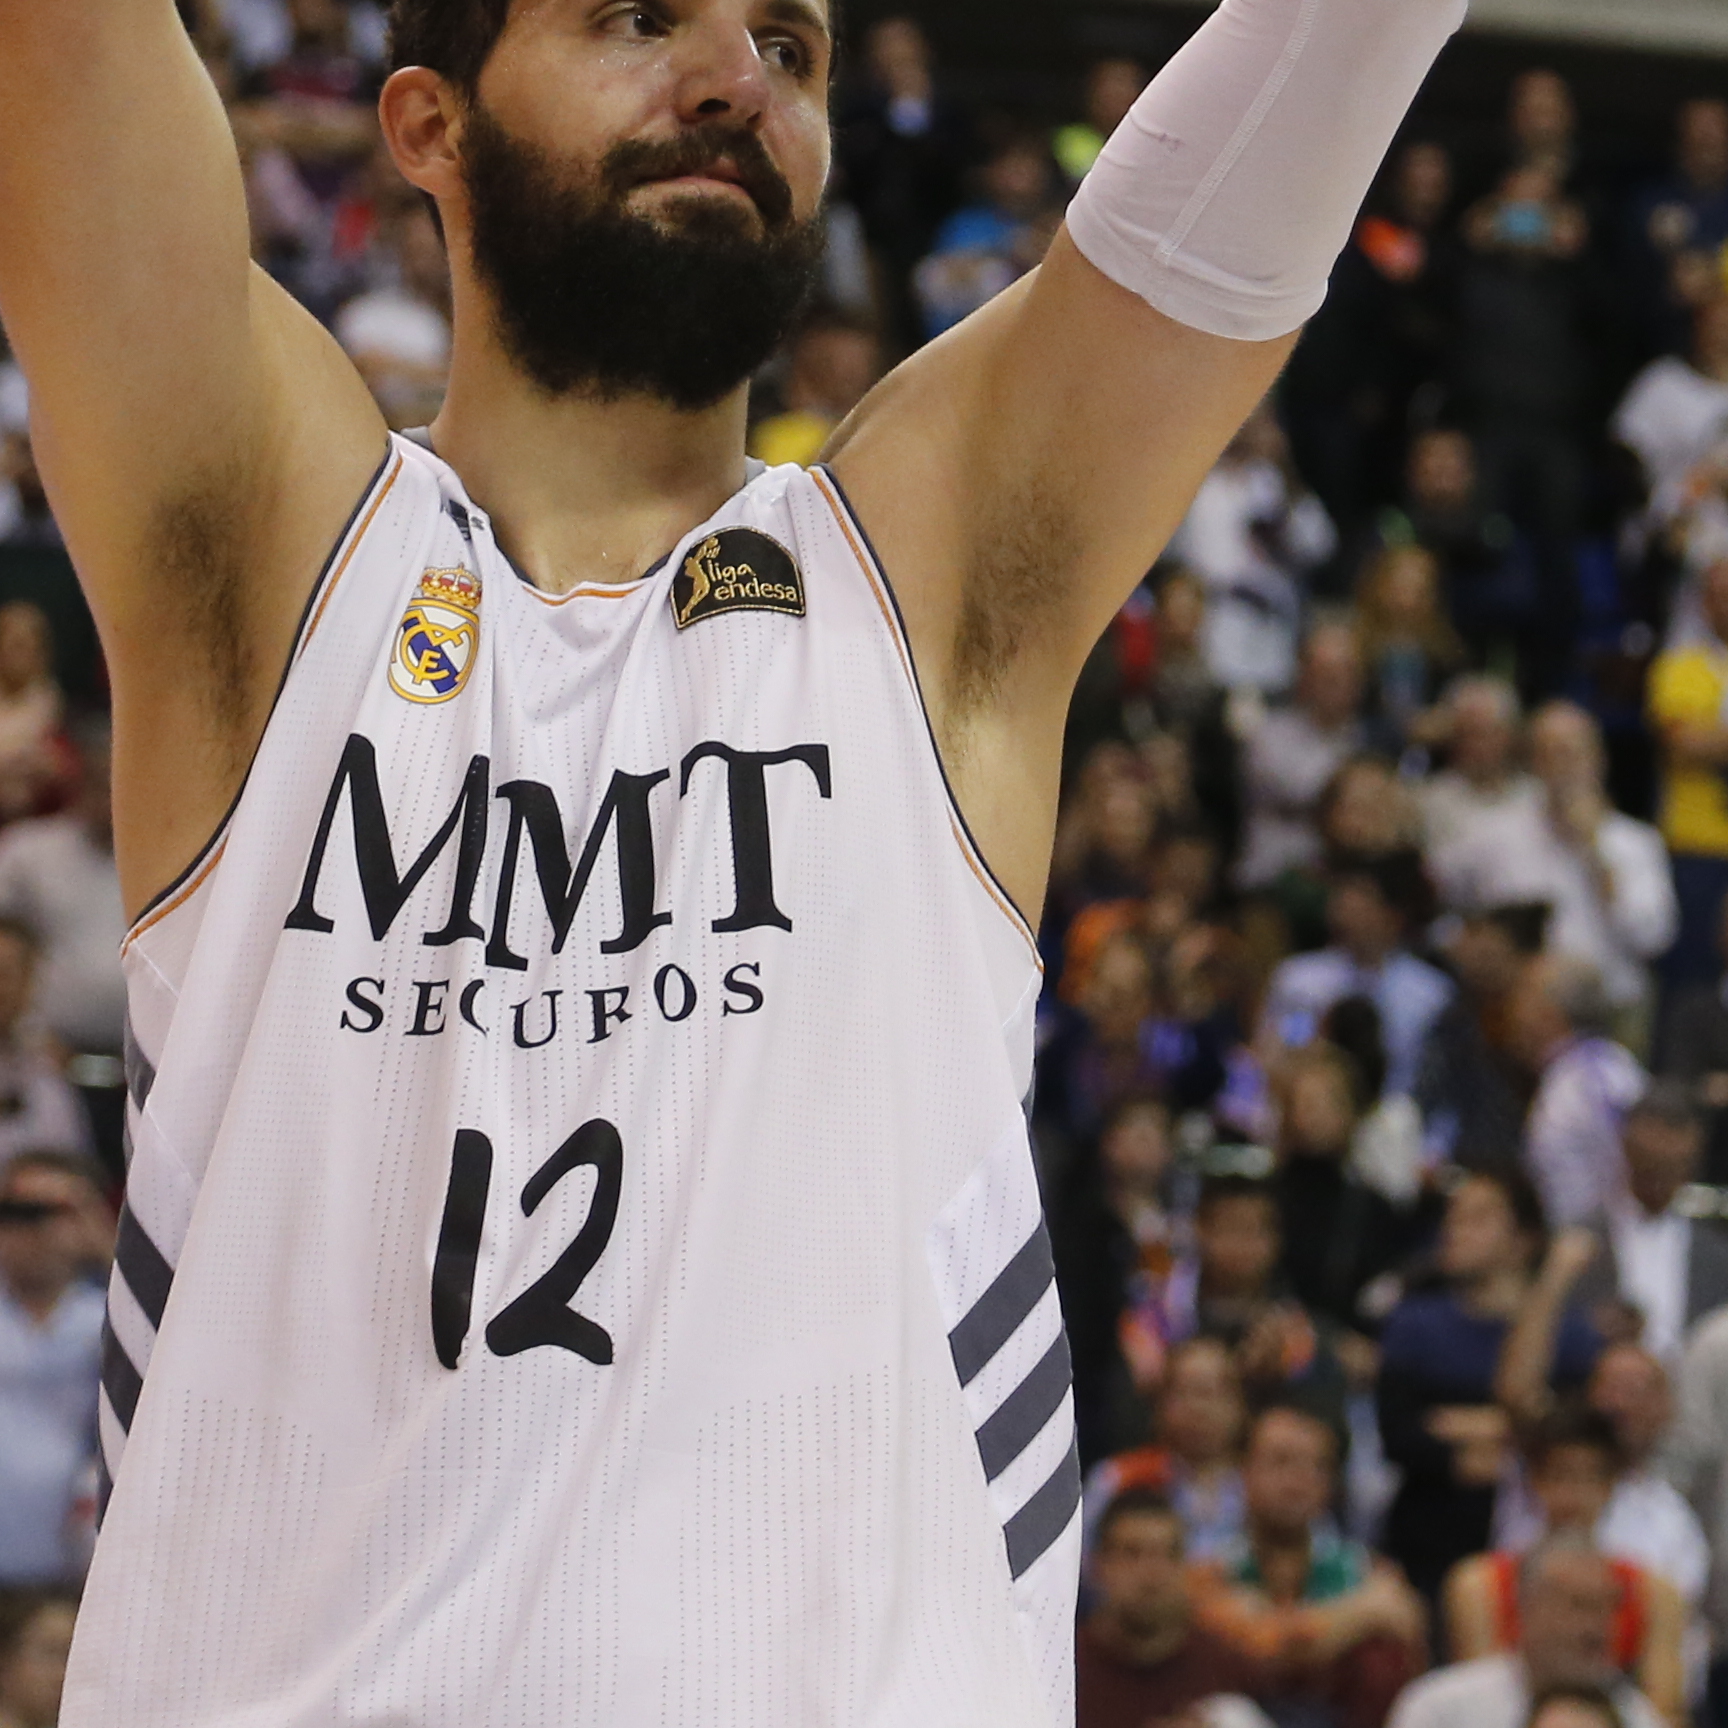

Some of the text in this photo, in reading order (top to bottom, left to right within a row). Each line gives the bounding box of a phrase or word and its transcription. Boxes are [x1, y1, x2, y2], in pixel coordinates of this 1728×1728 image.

[705, 558, 757, 585] liga
[713, 577, 798, 602] endesa
[283, 732, 833, 972] MMT
[430, 1117, 624, 1371] 12
